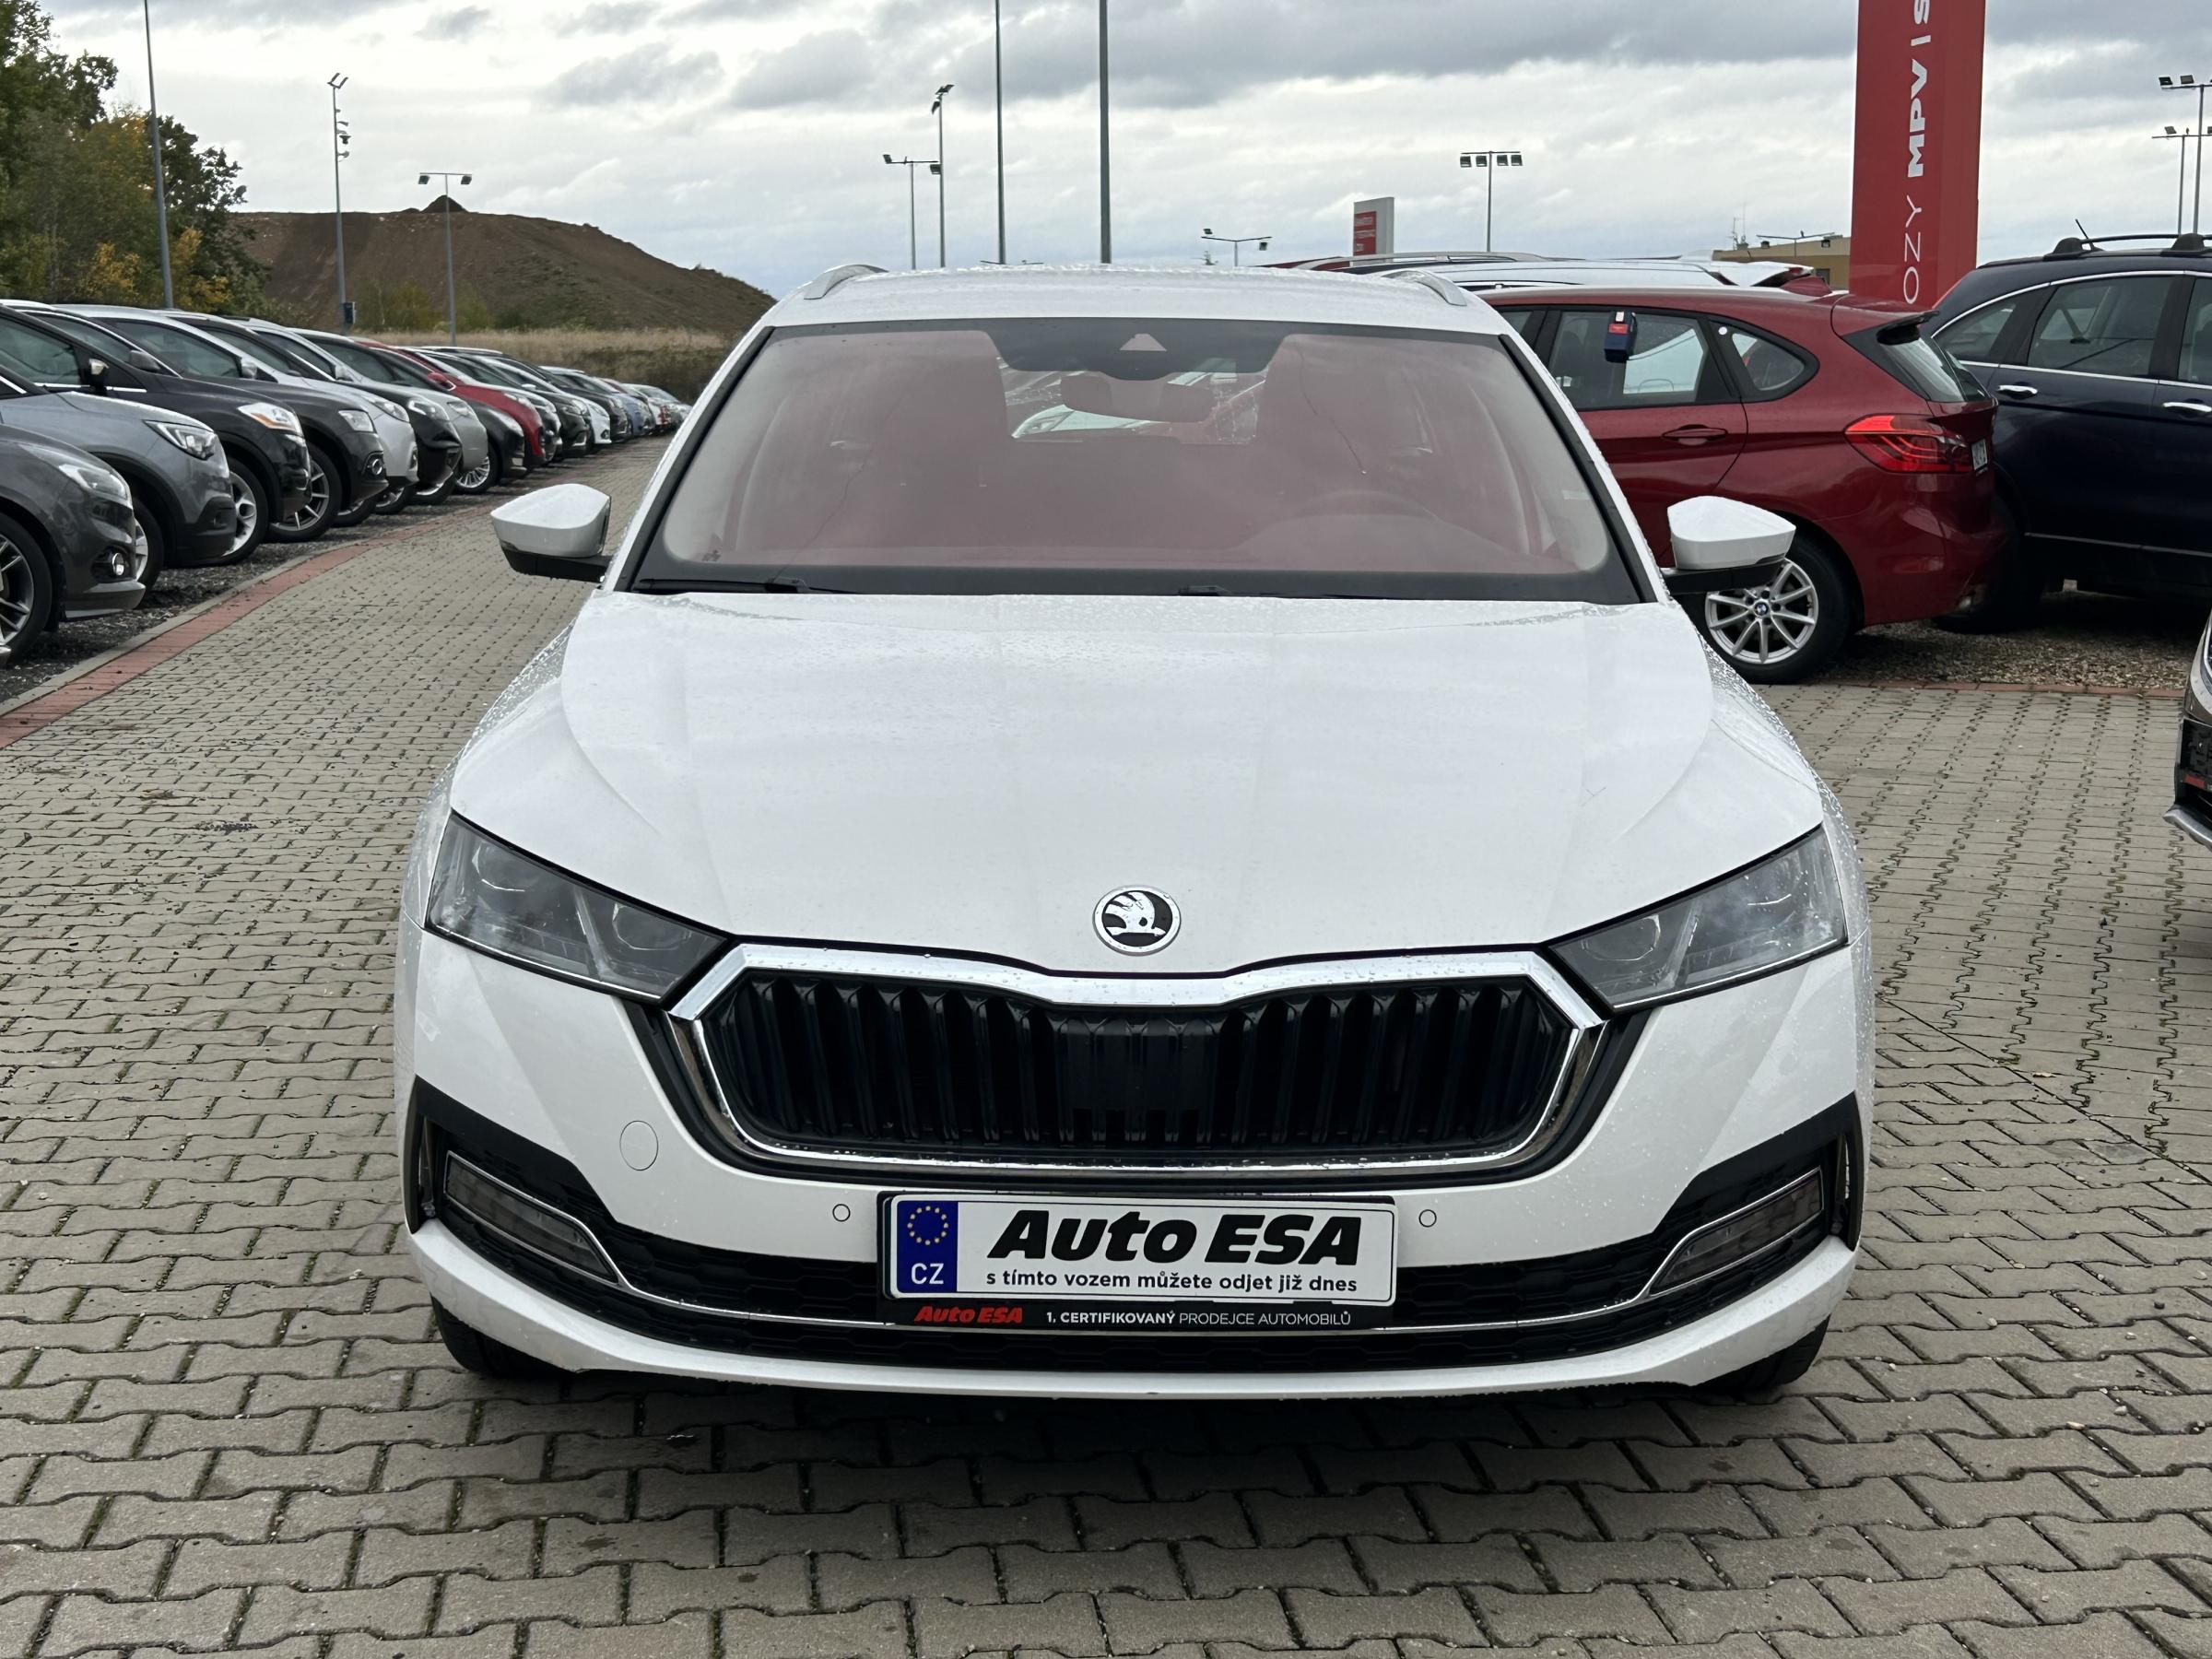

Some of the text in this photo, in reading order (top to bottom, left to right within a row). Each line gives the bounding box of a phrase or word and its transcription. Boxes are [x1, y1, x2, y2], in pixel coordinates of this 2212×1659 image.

[1907, 58, 1928, 178] MPV
[987, 1209, 1362, 1266] Auto ESA
[910, 1263, 945, 1286] CZ
[986, 1269, 1358, 1294] s tímto vozem můžete odjet již dnes
[913, 1305, 1024, 1324] Auto ESA
[1046, 1310, 1351, 1326] 1. CERTIFIKOVANÝ PRODEJCE AUTOMOBILŮ
